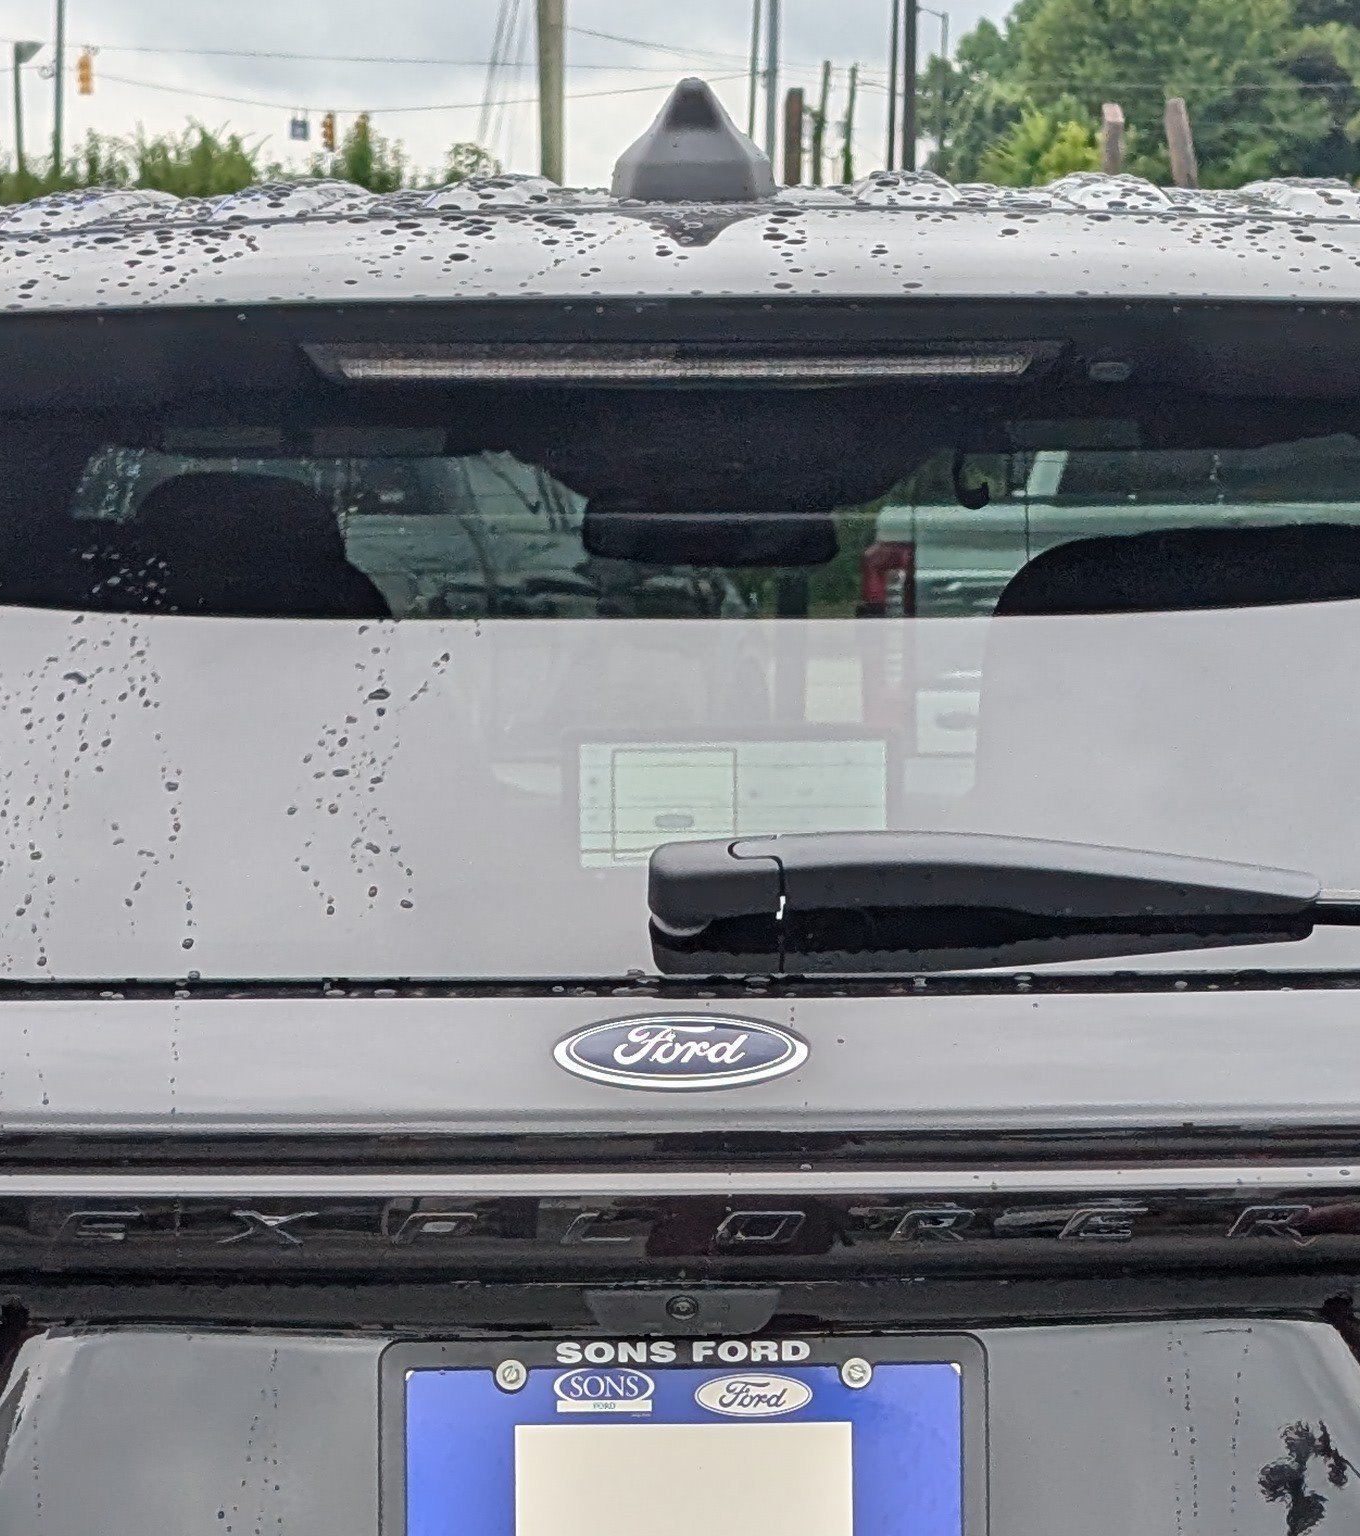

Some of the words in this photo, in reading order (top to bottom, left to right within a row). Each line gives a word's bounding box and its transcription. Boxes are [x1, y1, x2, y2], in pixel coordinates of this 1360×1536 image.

[613, 1024, 750, 1065] Ford
[54, 1204, 1314, 1246] EXPLORER
[556, 1341, 677, 1364] SONS
[692, 1340, 811, 1363] FORD
[569, 1374, 639, 1398] SONS
[718, 1380, 788, 1409] Ford
[593, 1403, 616, 1411] FORD
